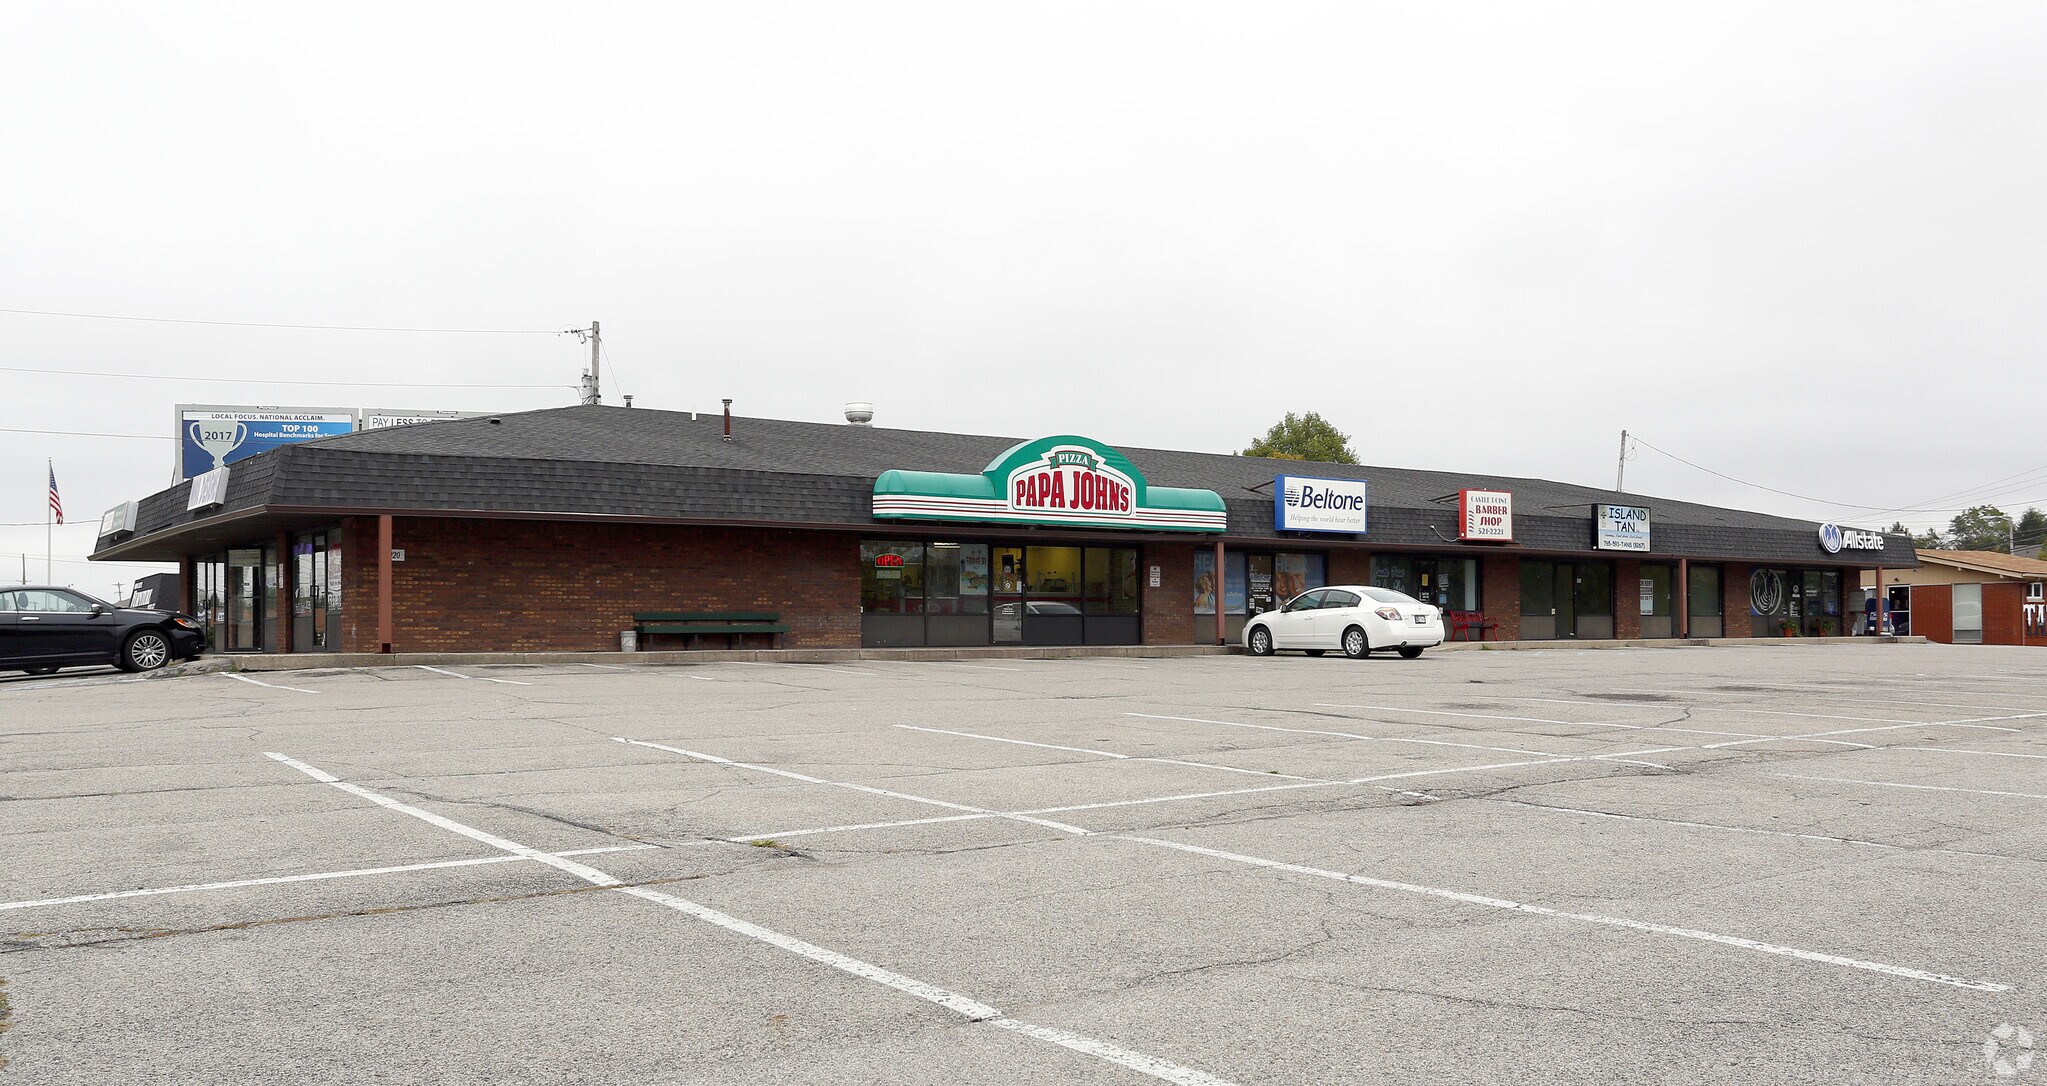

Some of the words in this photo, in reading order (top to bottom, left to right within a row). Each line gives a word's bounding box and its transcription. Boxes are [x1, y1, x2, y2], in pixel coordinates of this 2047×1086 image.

[372, 417, 389, 428] PAY
[282, 424, 300, 433] TOP
[302, 425, 319, 433] 100
[204, 431, 232, 441] 2017
[254, 432, 279, 440] Hospital
[1058, 453, 1089, 465] PIZZA
[1016, 471, 1066, 508] PAPA
[1300, 485, 1364, 511] Beltone
[1475, 505, 1508, 515] BARBER
[1609, 507, 1647, 521] ISLAND
[1290, 514, 1310, 523] Helping
[1480, 516, 1502, 526] SHOP
[1615, 521, 1636, 532] TAN
[1842, 530, 1884, 550] Allstate
[877, 554, 903, 566] OPEN
[2023, 604, 2047, 637] TA
